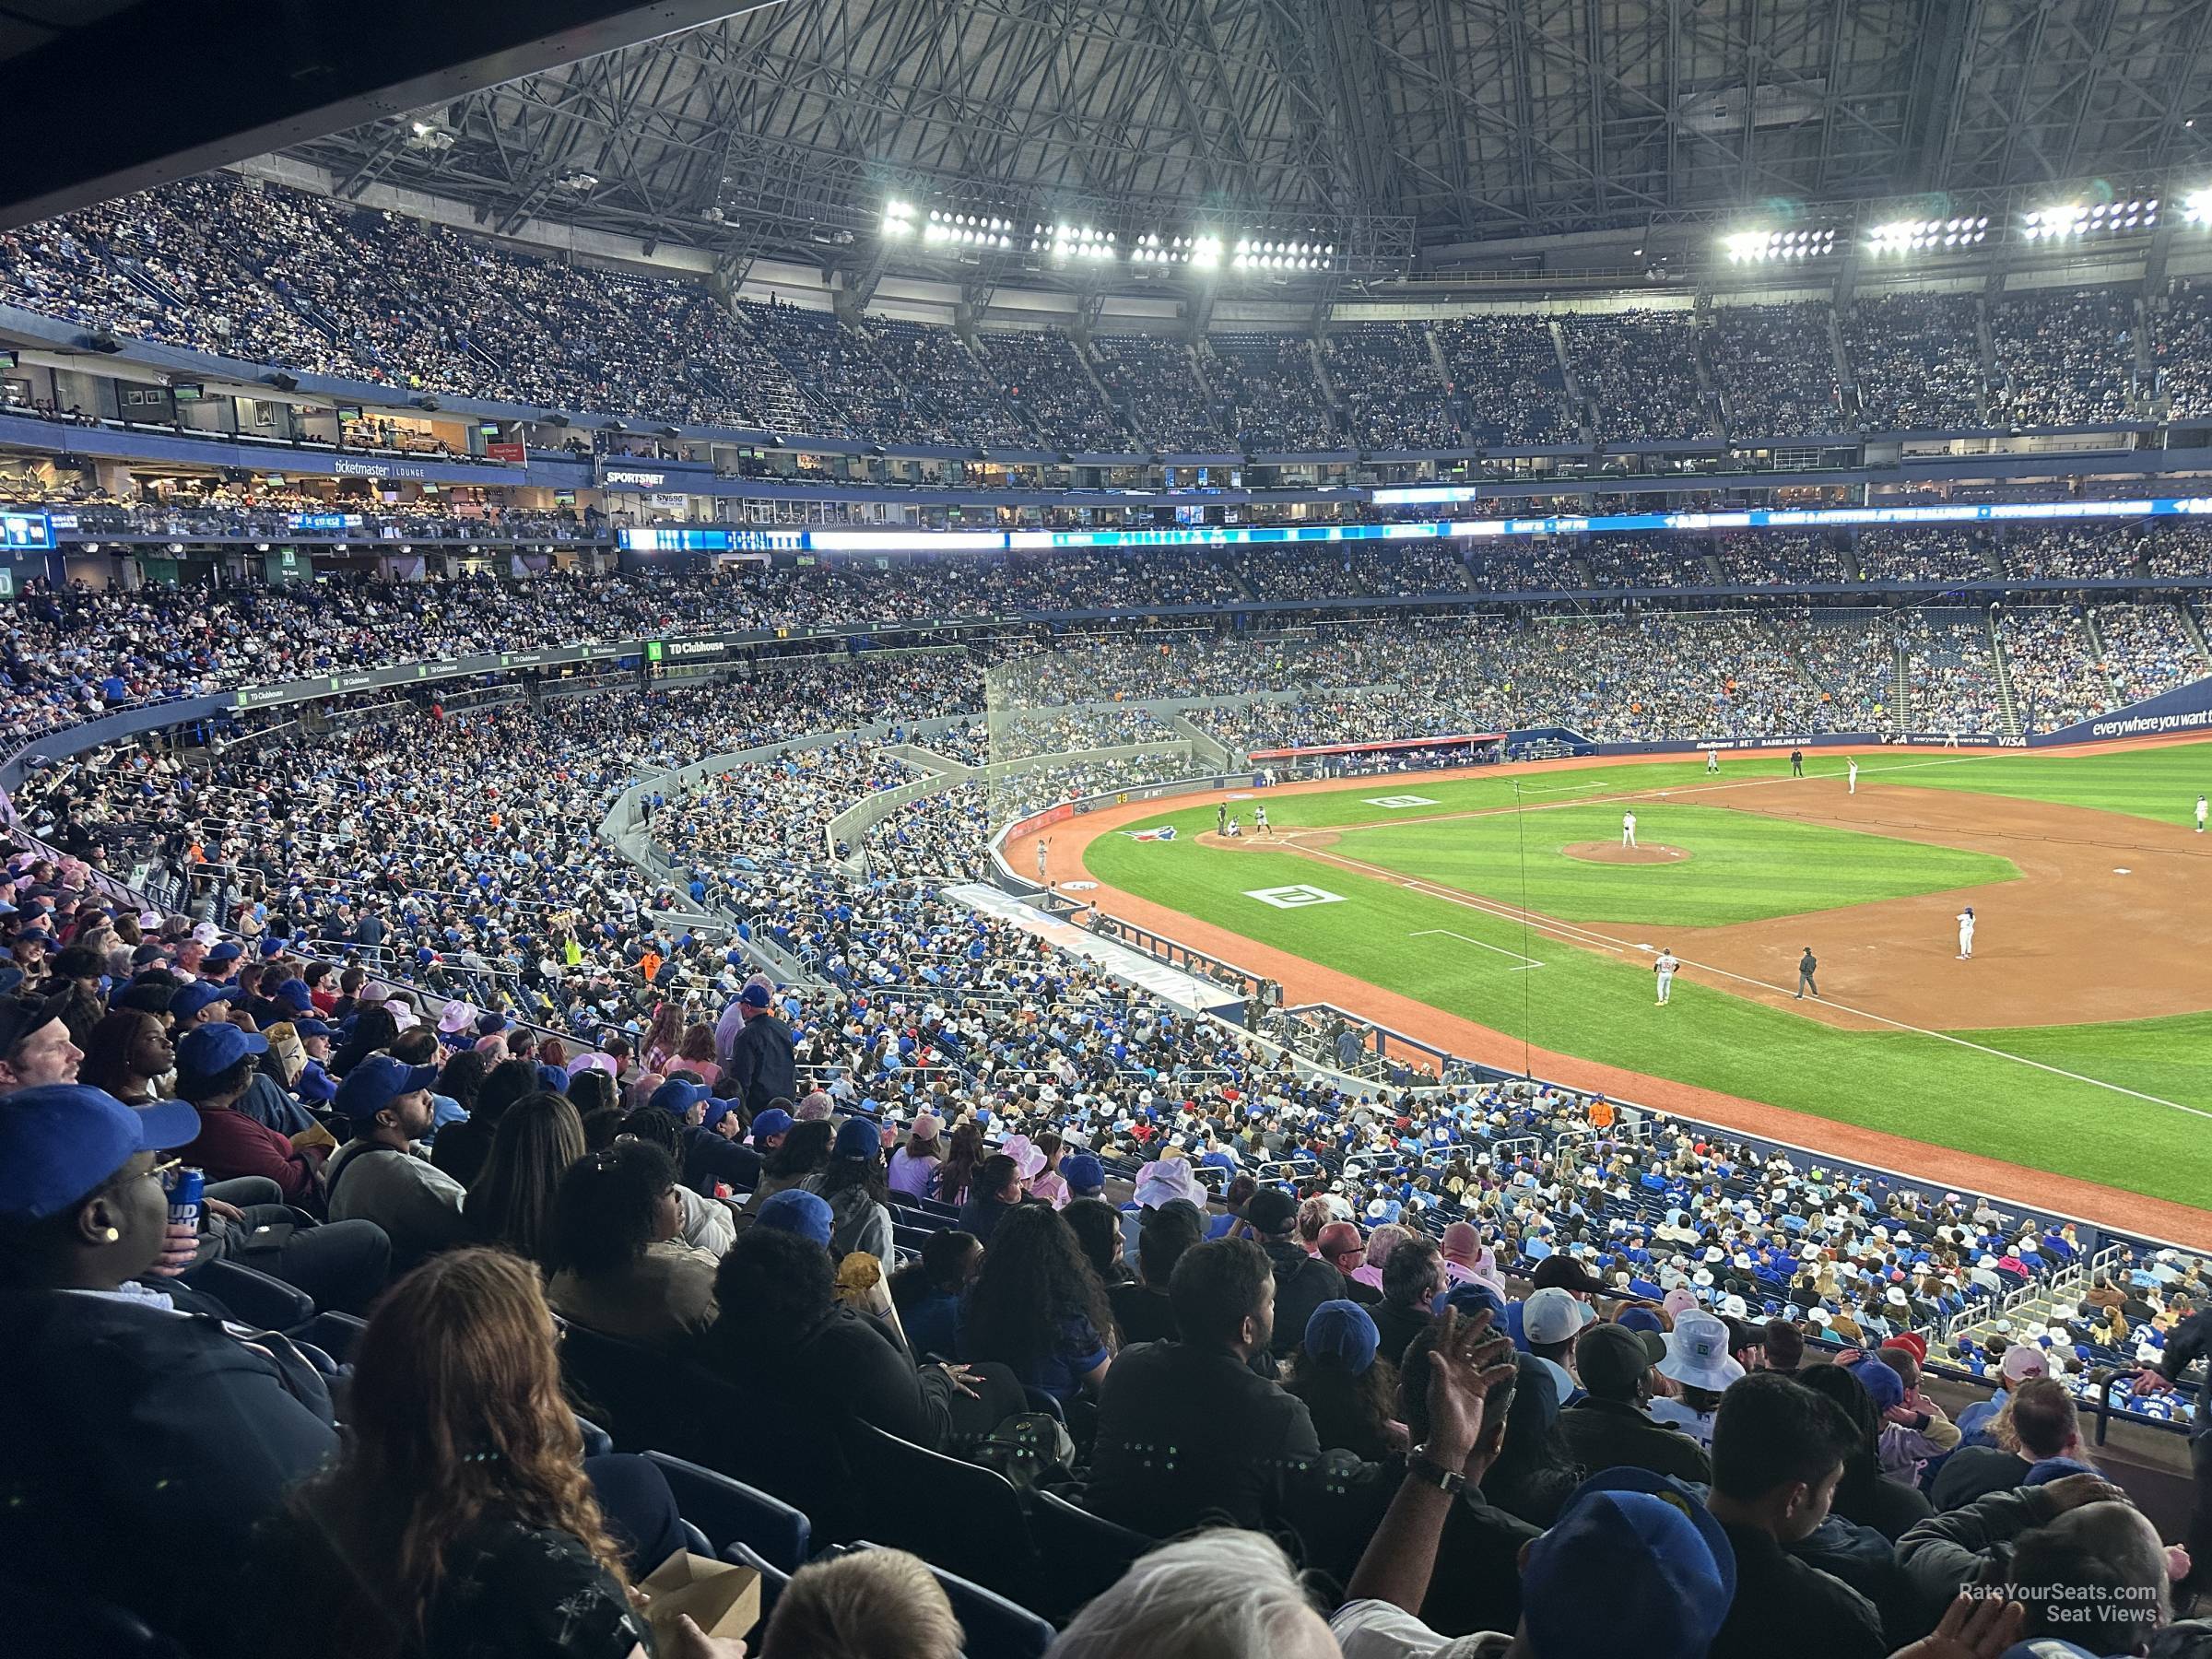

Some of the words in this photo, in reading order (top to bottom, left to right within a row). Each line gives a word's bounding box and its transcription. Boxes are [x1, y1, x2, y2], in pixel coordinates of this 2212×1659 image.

[335, 460, 389, 477] ticketmaster
[396, 467, 425, 477] LOUNGE
[606, 472, 665, 485] SPORTSNET
[668, 643, 681, 655] TD
[682, 641, 724, 653] Clubhouse
[258, 690, 283, 700] Clubhouse
[2092, 715, 2159, 735] everywhere
[2158, 713, 2180, 731] you
[2181, 710, 2207, 725] want
[1761, 738, 1795, 747] BASELINE
[1995, 735, 2027, 747] VISA
[1267, 888, 1325, 903] TD
